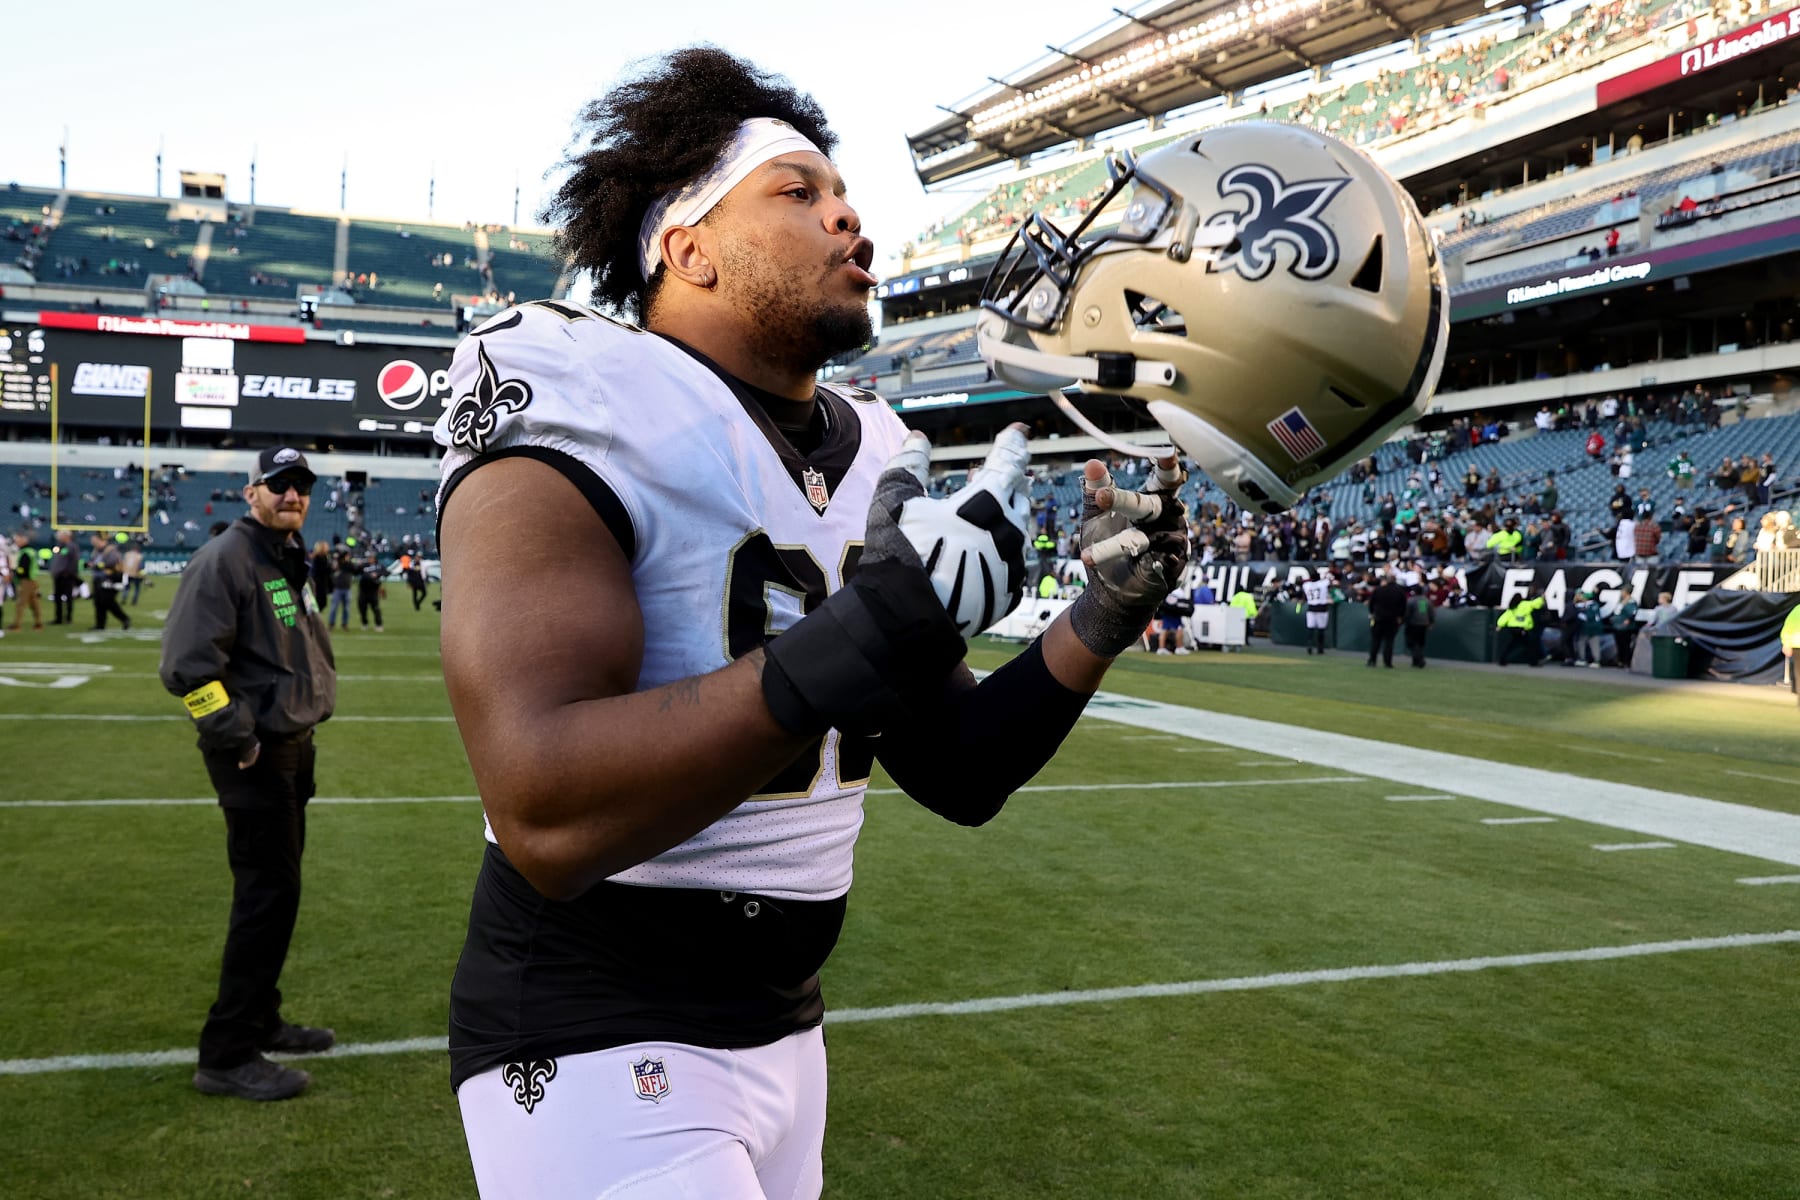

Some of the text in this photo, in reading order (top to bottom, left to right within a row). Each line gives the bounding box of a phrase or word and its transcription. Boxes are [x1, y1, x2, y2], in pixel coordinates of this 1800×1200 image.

[1702, 19, 1787, 68] Lincoln
[1518, 280, 1559, 301] Lincoln
[1610, 261, 1651, 282] Group
[72, 362, 151, 392] GIANTS
[241, 374, 357, 402] EAGLES
[810, 486, 827, 503] NFL
[639, 1075, 666, 1094] NFL
